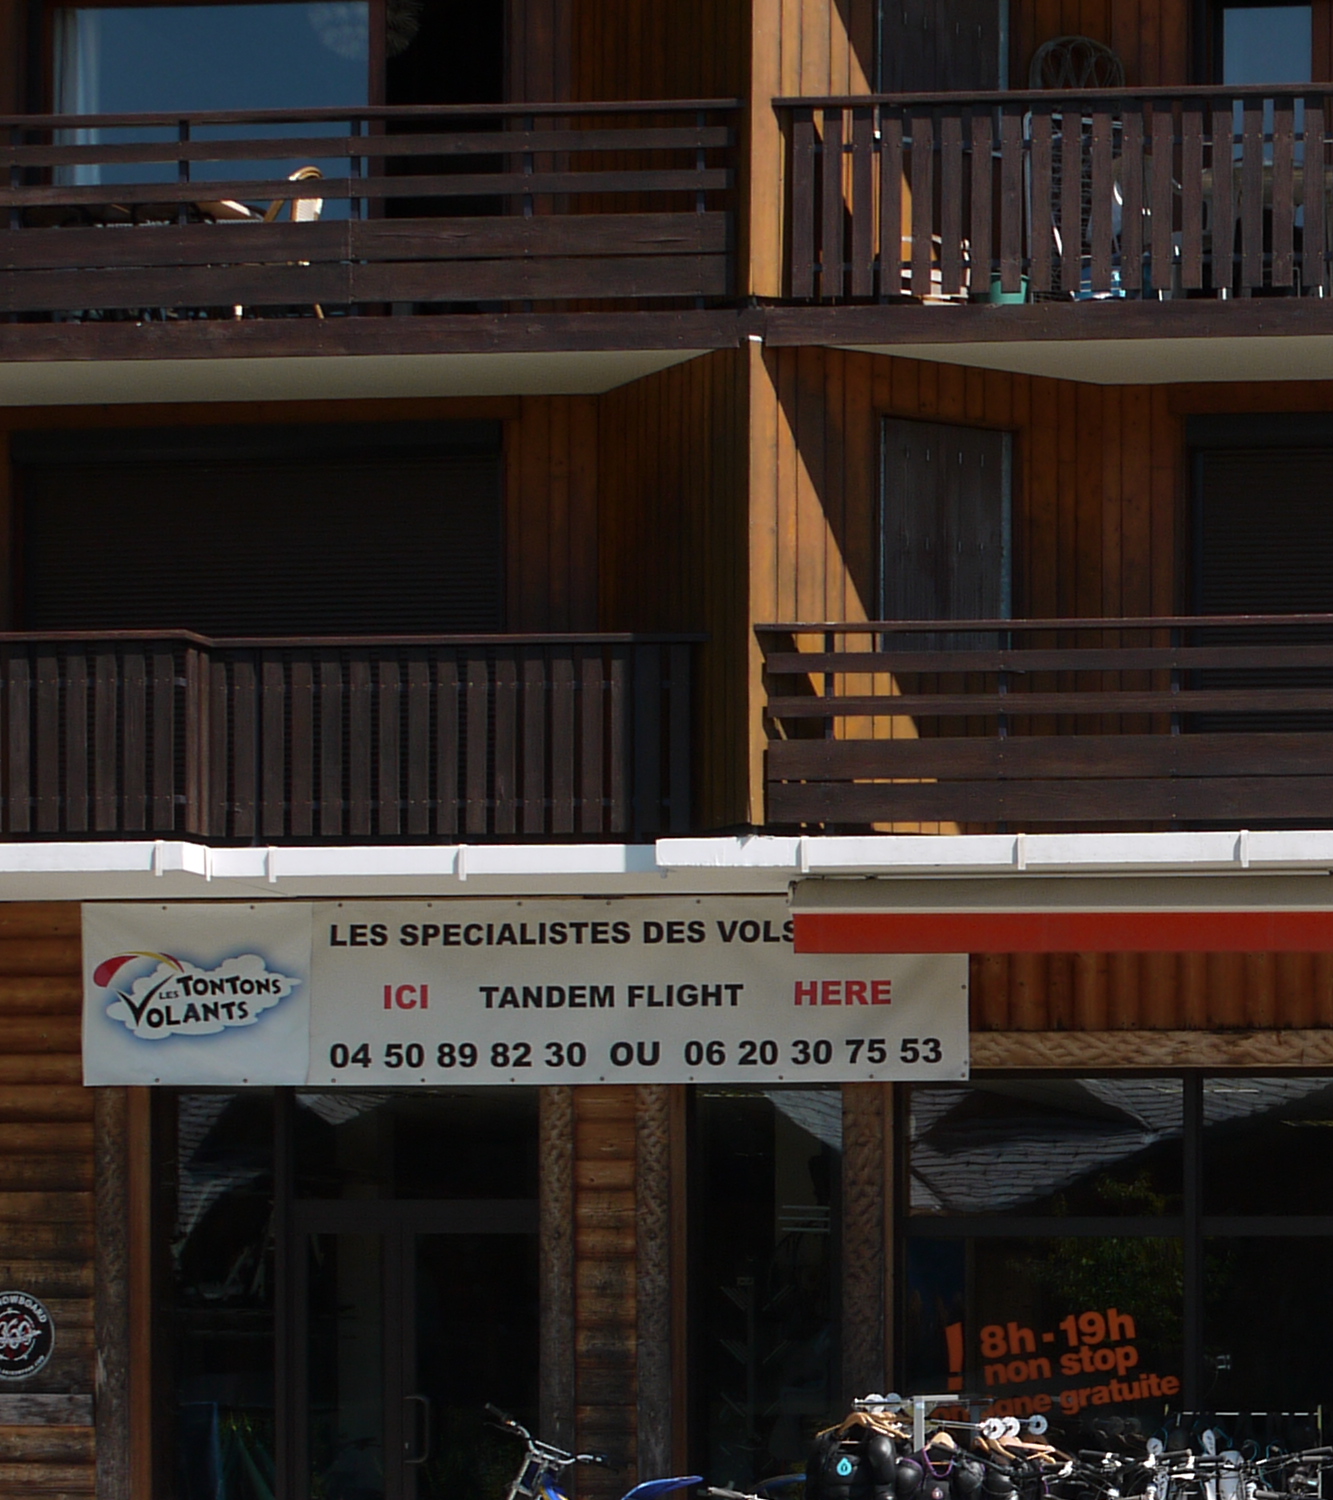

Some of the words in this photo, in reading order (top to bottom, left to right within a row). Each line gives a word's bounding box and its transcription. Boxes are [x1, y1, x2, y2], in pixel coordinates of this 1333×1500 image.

[330, 924, 388, 947] LES
[399, 921, 631, 946] SPECIALISTES
[643, 920, 706, 944] DES
[115, 973, 249, 1029] VOLANTS
[158, 990, 179, 1000] LES
[176, 974, 282, 997] TONTONS
[383, 984, 429, 1010] ICI
[479, 985, 615, 1009] TANDEM
[627, 983, 744, 1007] FLIGHT
[794, 979, 892, 1006] HERE
[329, 1043, 372, 1068] 04
[383, 1043, 425, 1068] 50
[437, 1043, 478, 1068] 89
[490, 1042, 532, 1068] 82
[544, 1042, 587, 1067] 30
[610, 1041, 661, 1066] OU
[684, 1040, 726, 1066] 06
[737, 1040, 779, 1066] 20
[791, 1039, 833, 1065] 30
[845, 1038, 887, 1064] 75
[899, 1038, 943, 1064] 53
[0, 1295, 48, 1323] OWBOARD
[979, 1321, 1036, 1359] 8h
[1059, 1307, 1136, 1347] 19h
[983, 1357, 1052, 1387] non
[1060, 1345, 1139, 1377] stop
[1060, 1373, 1181, 1416] gratuite
